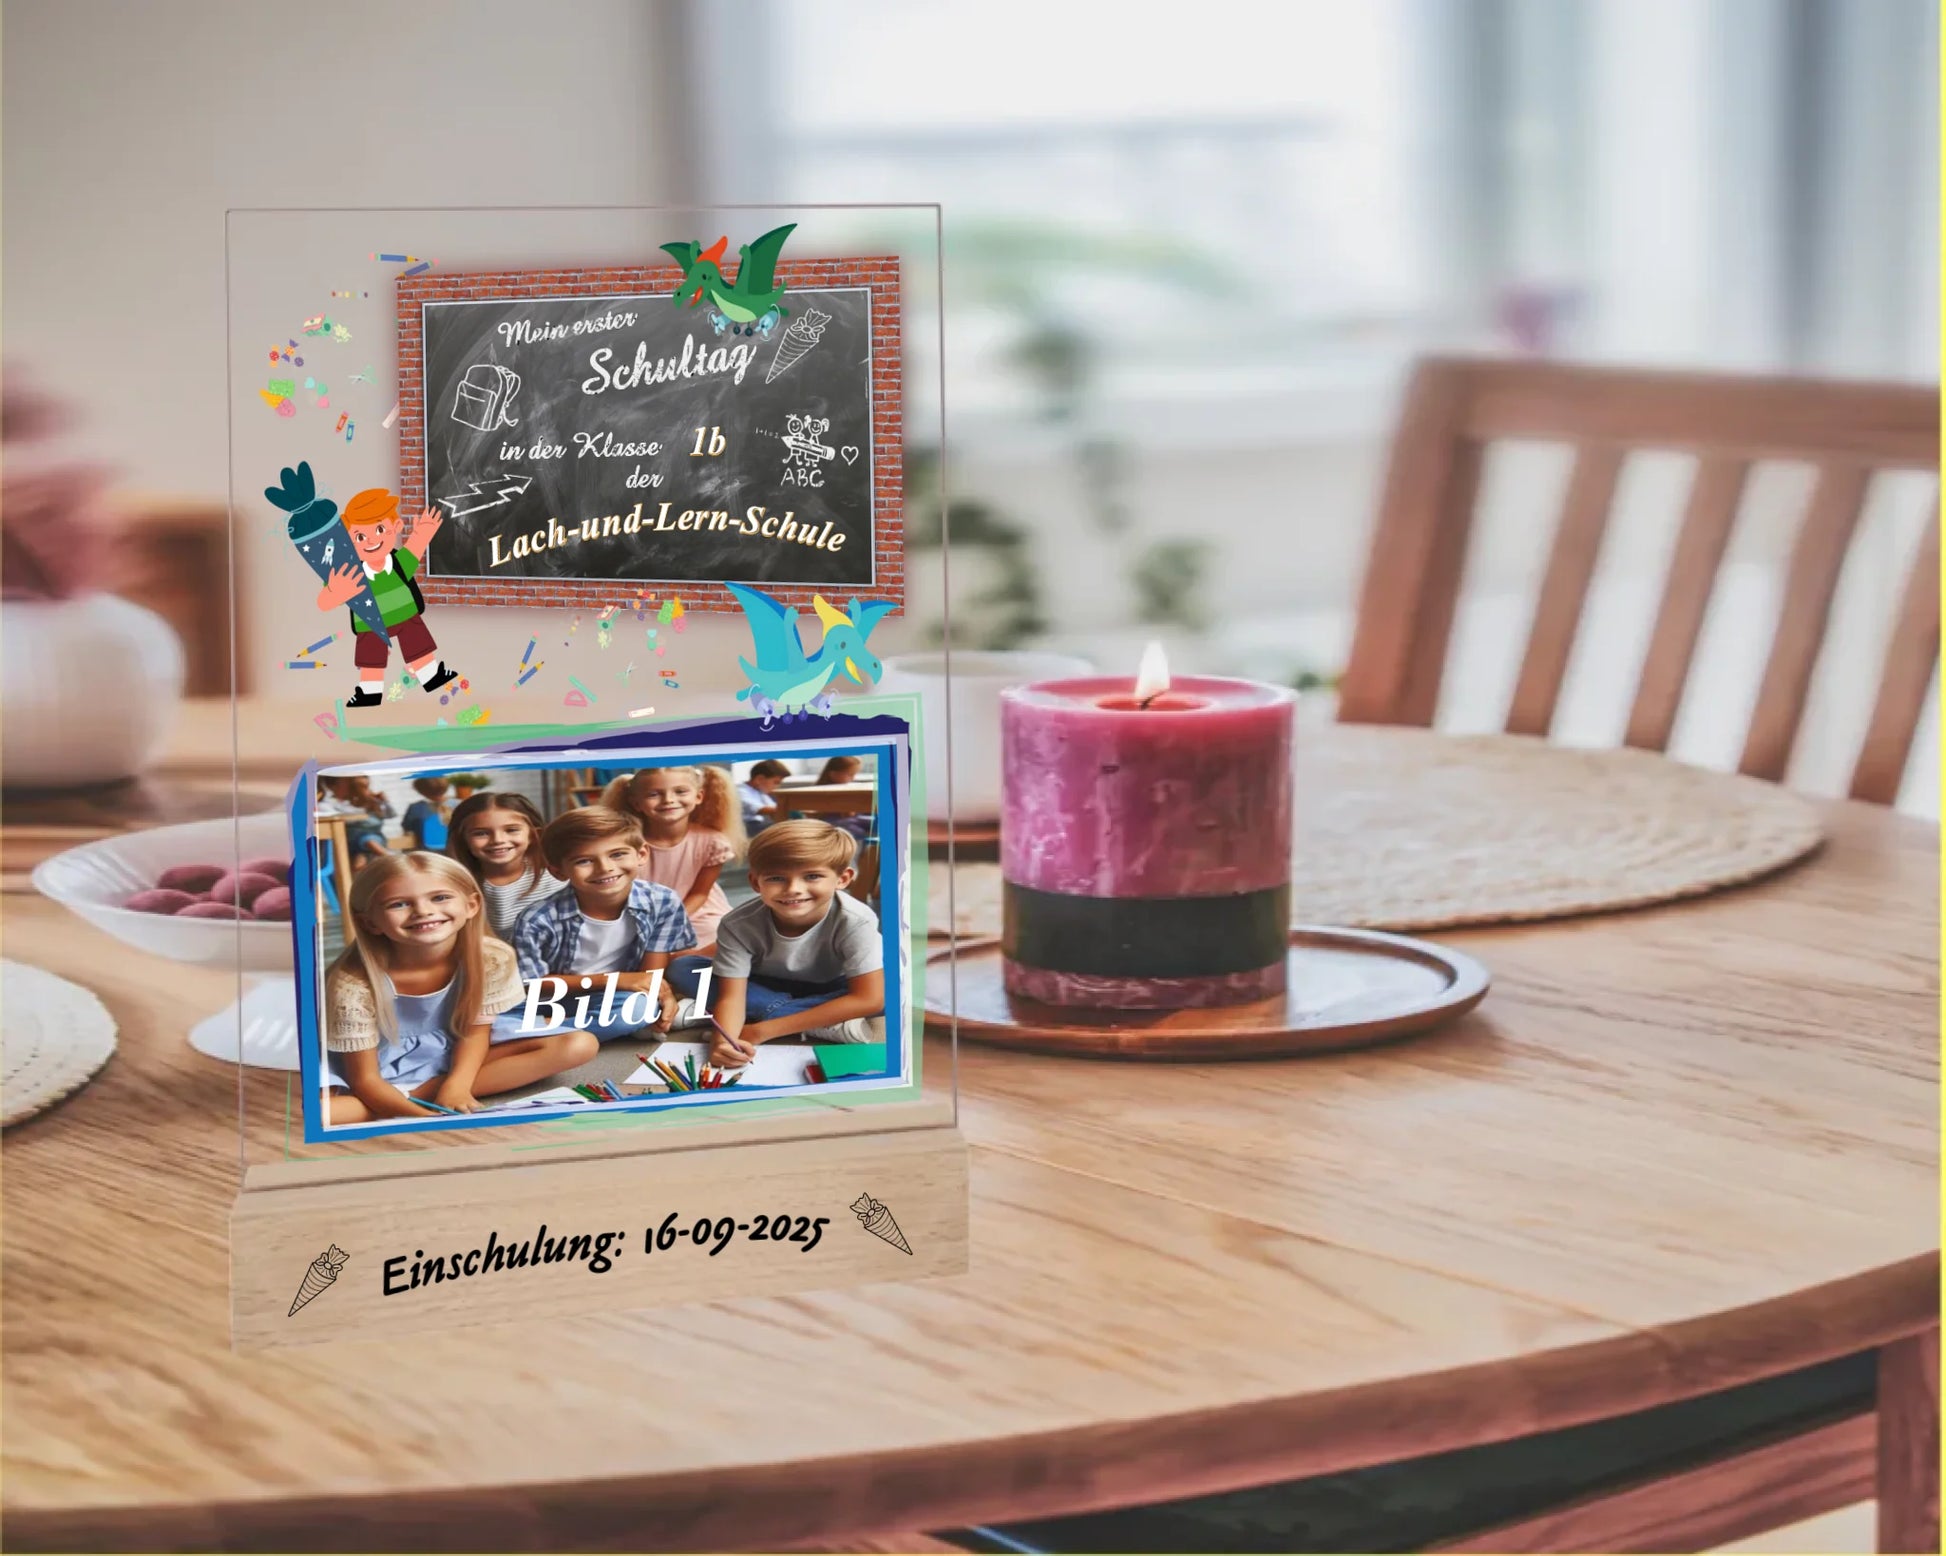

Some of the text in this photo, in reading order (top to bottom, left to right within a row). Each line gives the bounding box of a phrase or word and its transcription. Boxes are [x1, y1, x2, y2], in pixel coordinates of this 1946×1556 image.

[498, 310, 638, 348] Mein erster
[581, 334, 757, 396] Schultag
[500, 425, 727, 461] in der Klasse 1b
[626, 465, 664, 489] der
[780, 468, 825, 488] ABC
[488, 502, 847, 568] Lach-und-Lern-Schule
[515, 967, 715, 1034] Bild 1
[382, 1211, 831, 1297] Einschulung: 16-09-2025
